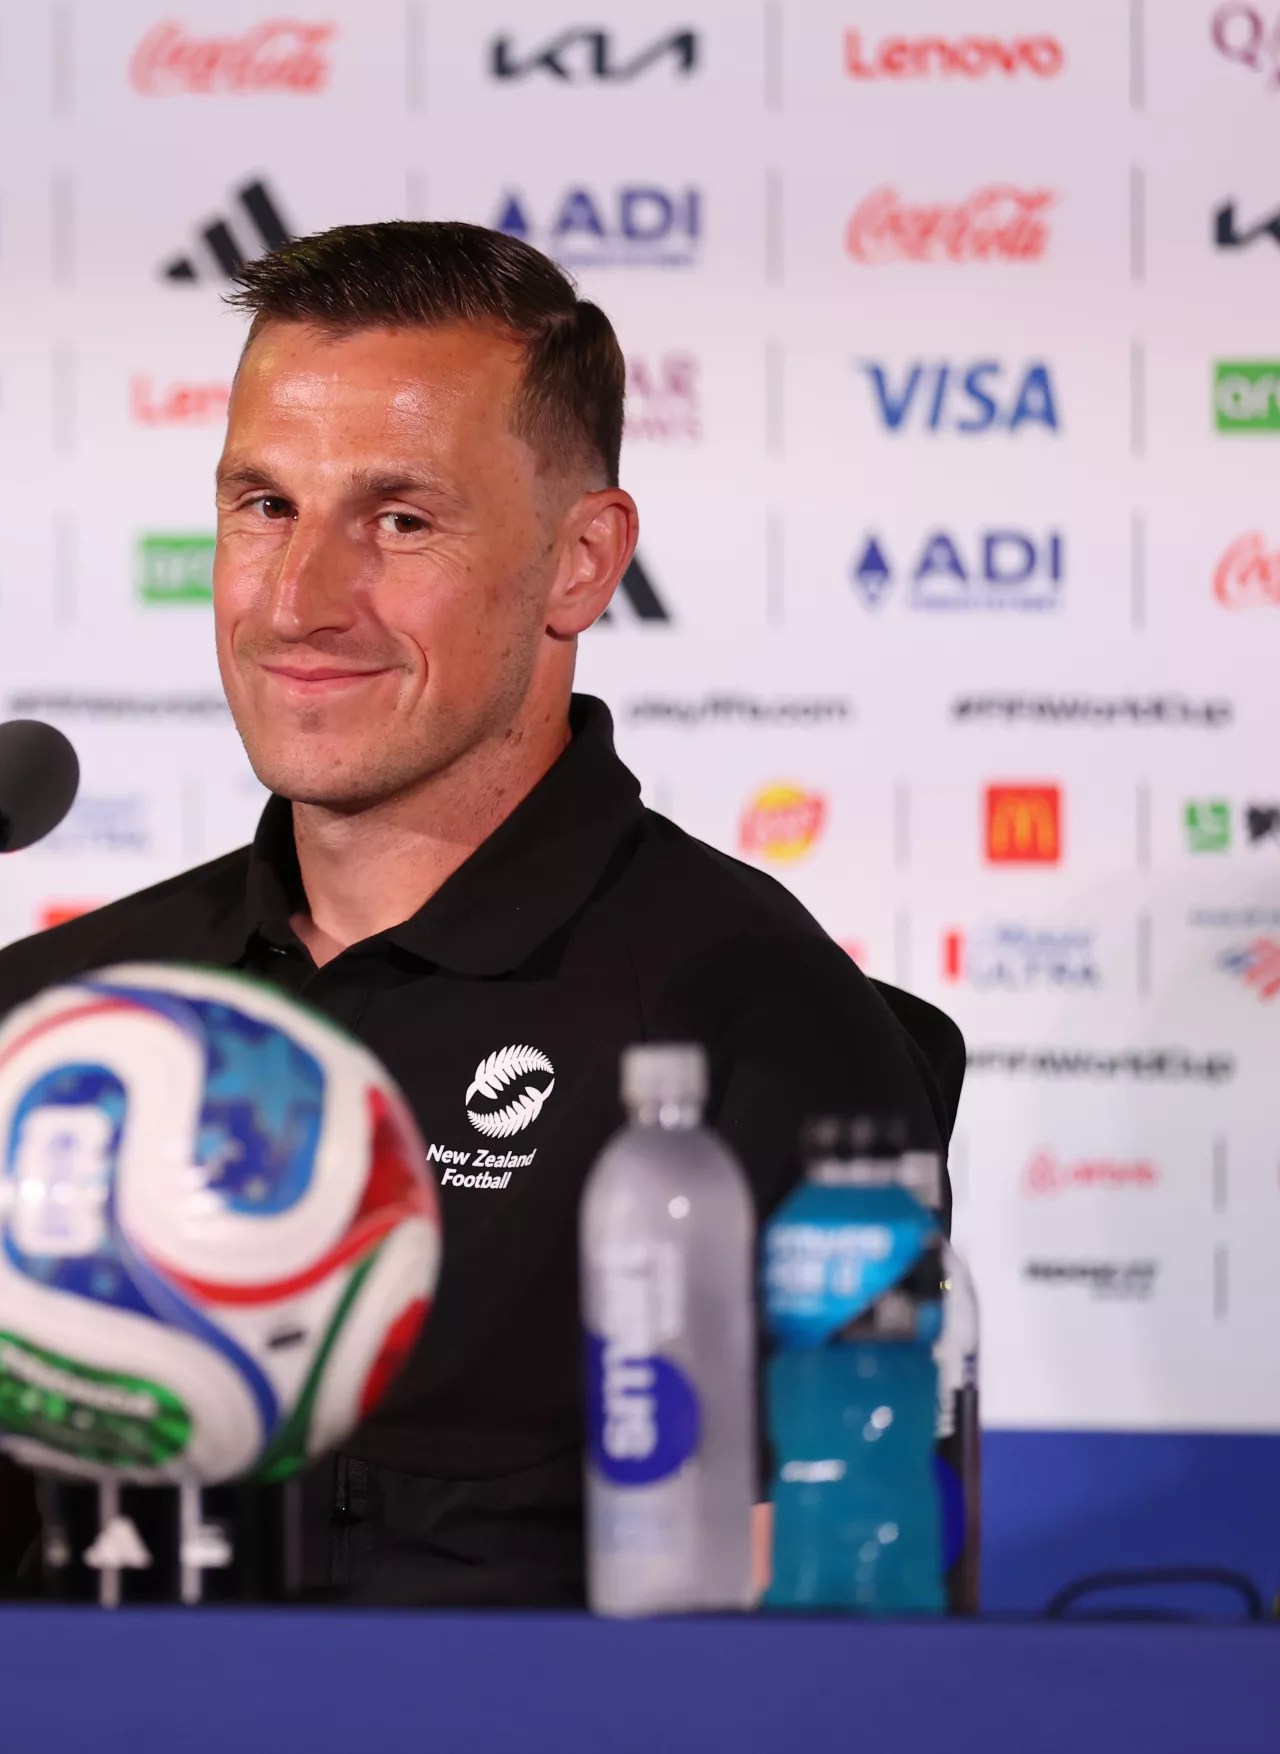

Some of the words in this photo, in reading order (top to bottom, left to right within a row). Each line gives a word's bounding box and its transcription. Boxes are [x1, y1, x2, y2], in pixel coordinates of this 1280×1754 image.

[845, 30, 1065, 80] Lenovo
[551, 187, 700, 240] ADI
[863, 360, 1060, 434] VISA
[914, 532, 1063, 583] ADI
[425, 1143, 471, 1166] New
[472, 1148, 538, 1169] Zealand
[440, 1167, 513, 1190] Football
